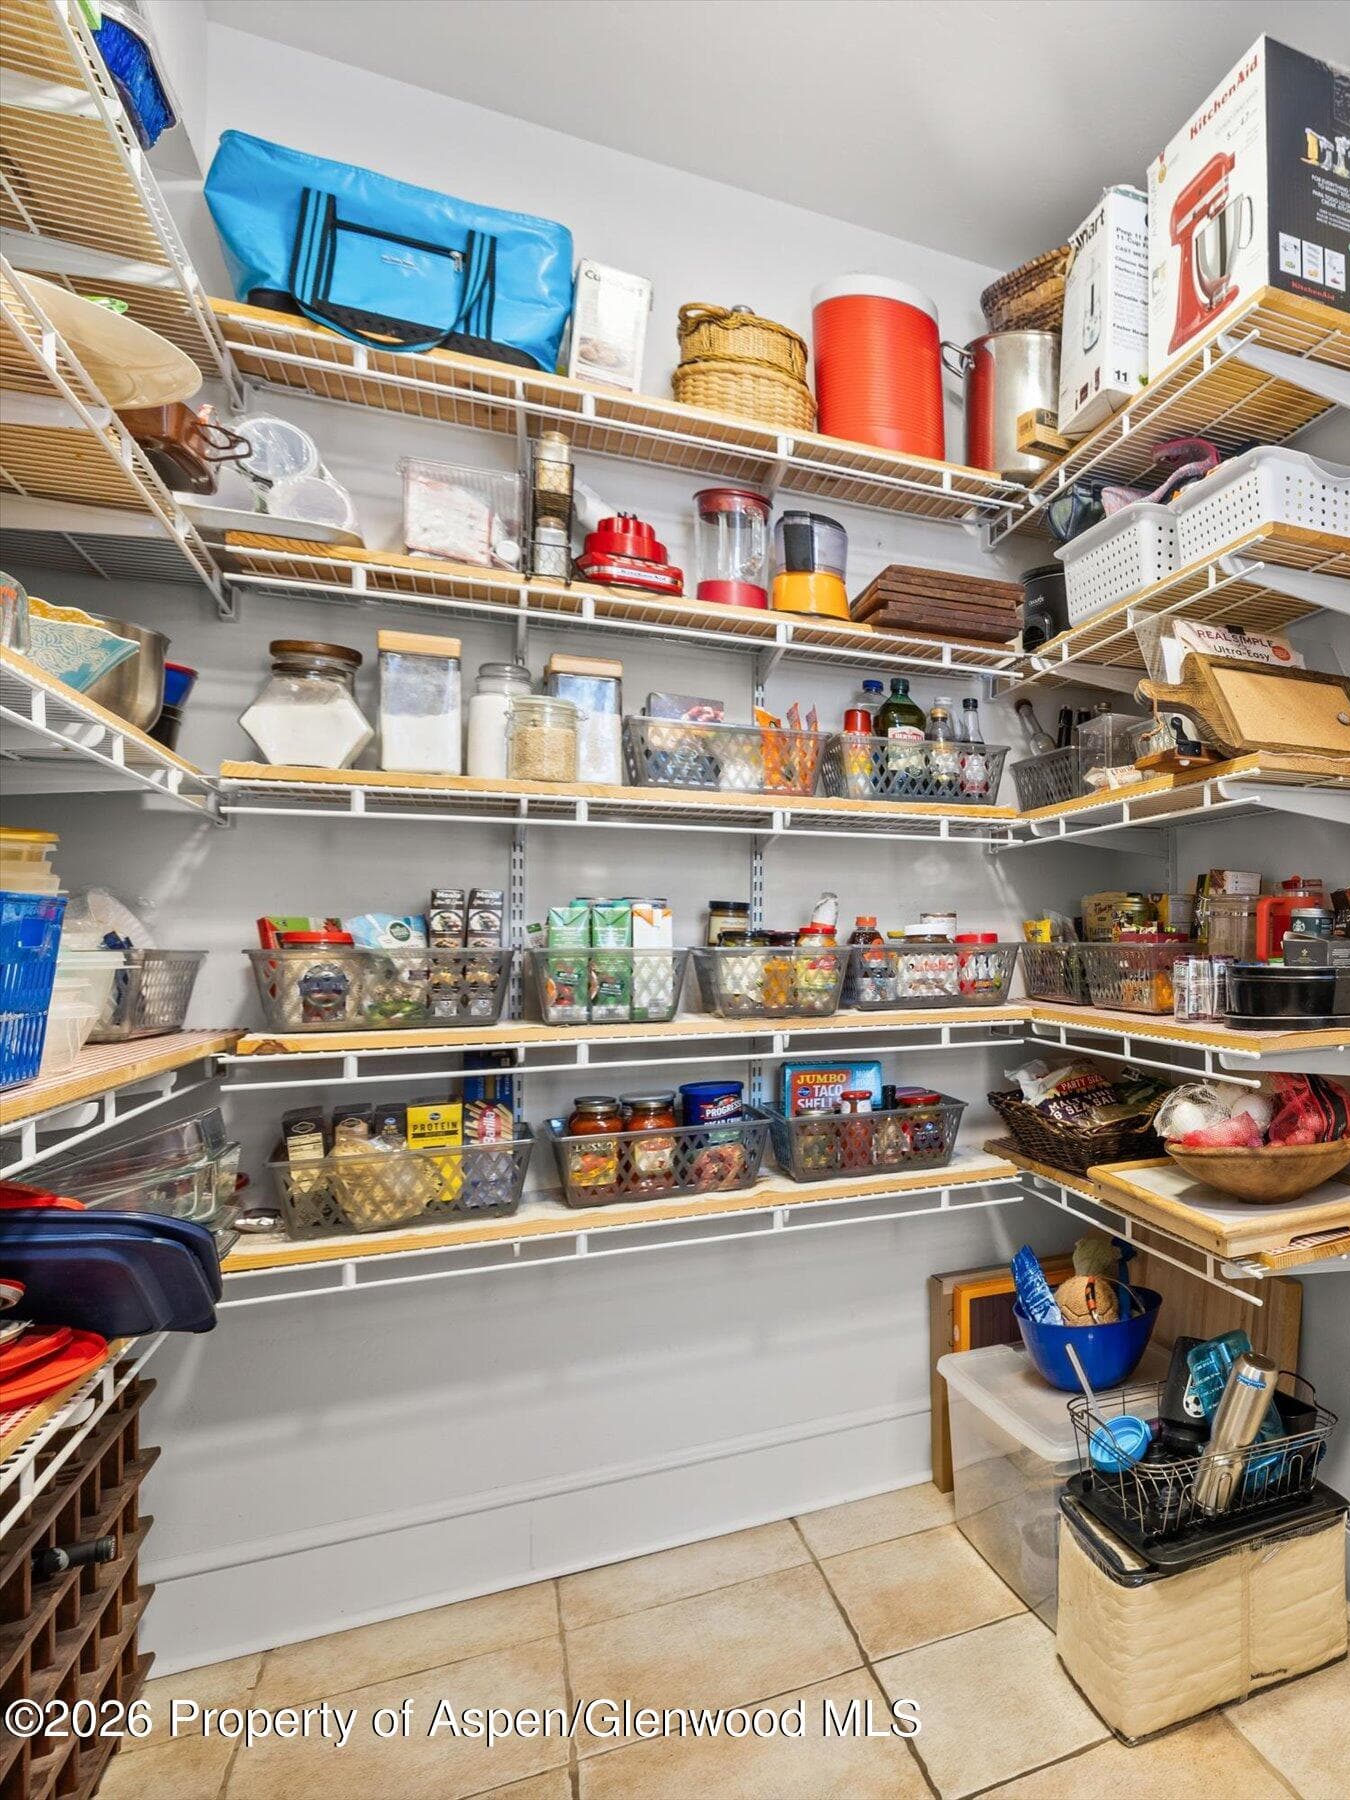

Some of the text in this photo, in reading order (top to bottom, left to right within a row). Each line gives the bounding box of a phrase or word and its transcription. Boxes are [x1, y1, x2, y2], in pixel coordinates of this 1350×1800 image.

[1190, 54, 1257, 140] KitchenAid
[1291, 279, 1335, 301] KitchenAid
[1115, 370, 1128, 382] 11
[1213, 644, 1271, 661] Ultra-Easy
[797, 1074, 847, 1084] JUMBO
[1060, 1077, 1086, 1091] PARTY
[813, 1085, 843, 1097] TACO
[1048, 1097, 1082, 1114] MALT
[1065, 1103, 1091, 1115] SEA
[1094, 1094, 1118, 1107] SAL
[413, 1121, 458, 1132] PROTEIN
[483, 1111, 497, 1145] Barilla
